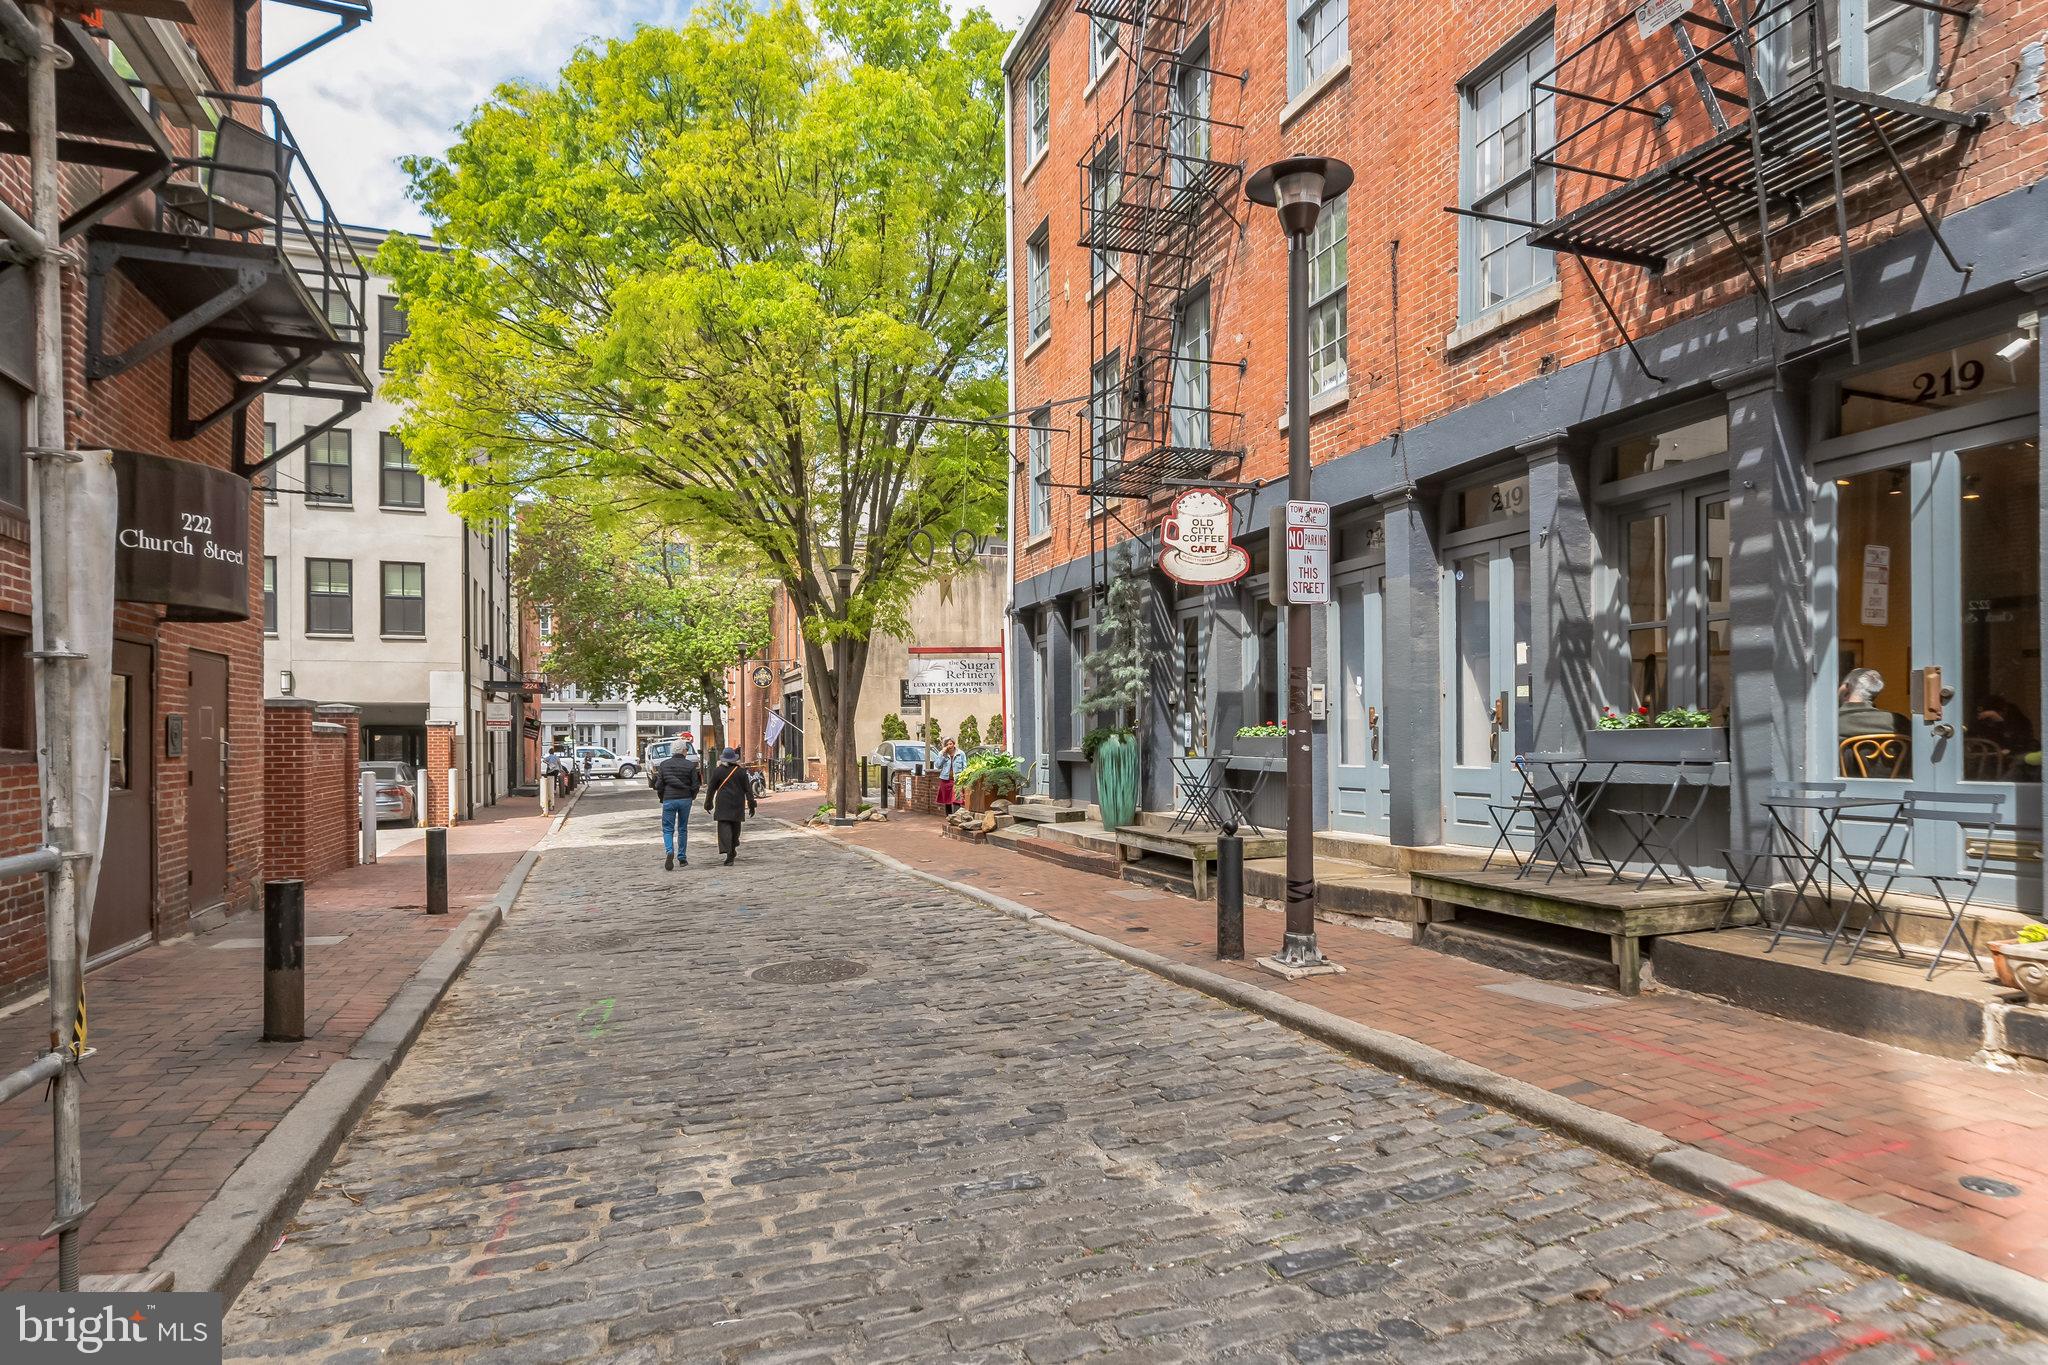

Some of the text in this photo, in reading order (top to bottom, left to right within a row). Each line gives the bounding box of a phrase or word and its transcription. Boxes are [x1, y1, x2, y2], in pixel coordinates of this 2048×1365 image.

[1912, 359, 1985, 402] 219
[1491, 485, 1524, 513] 219
[181, 512, 212, 535] 222
[1192, 518, 1214, 527] OLD
[1299, 515, 1317, 524] ZONE
[1190, 526, 1215, 535] CITY
[1182, 534, 1225, 543] COFFEE
[1288, 530, 1327, 548] NO PARKING
[119, 528, 244, 566] Church Street
[1190, 545, 1218, 554] CAFE
[1303, 555, 1312, 565] IN
[1298, 566, 1319, 579] THIS
[1292, 581, 1325, 594] STREET
[959, 659, 996, 672] Sugar
[946, 670, 996, 681] Refinery
